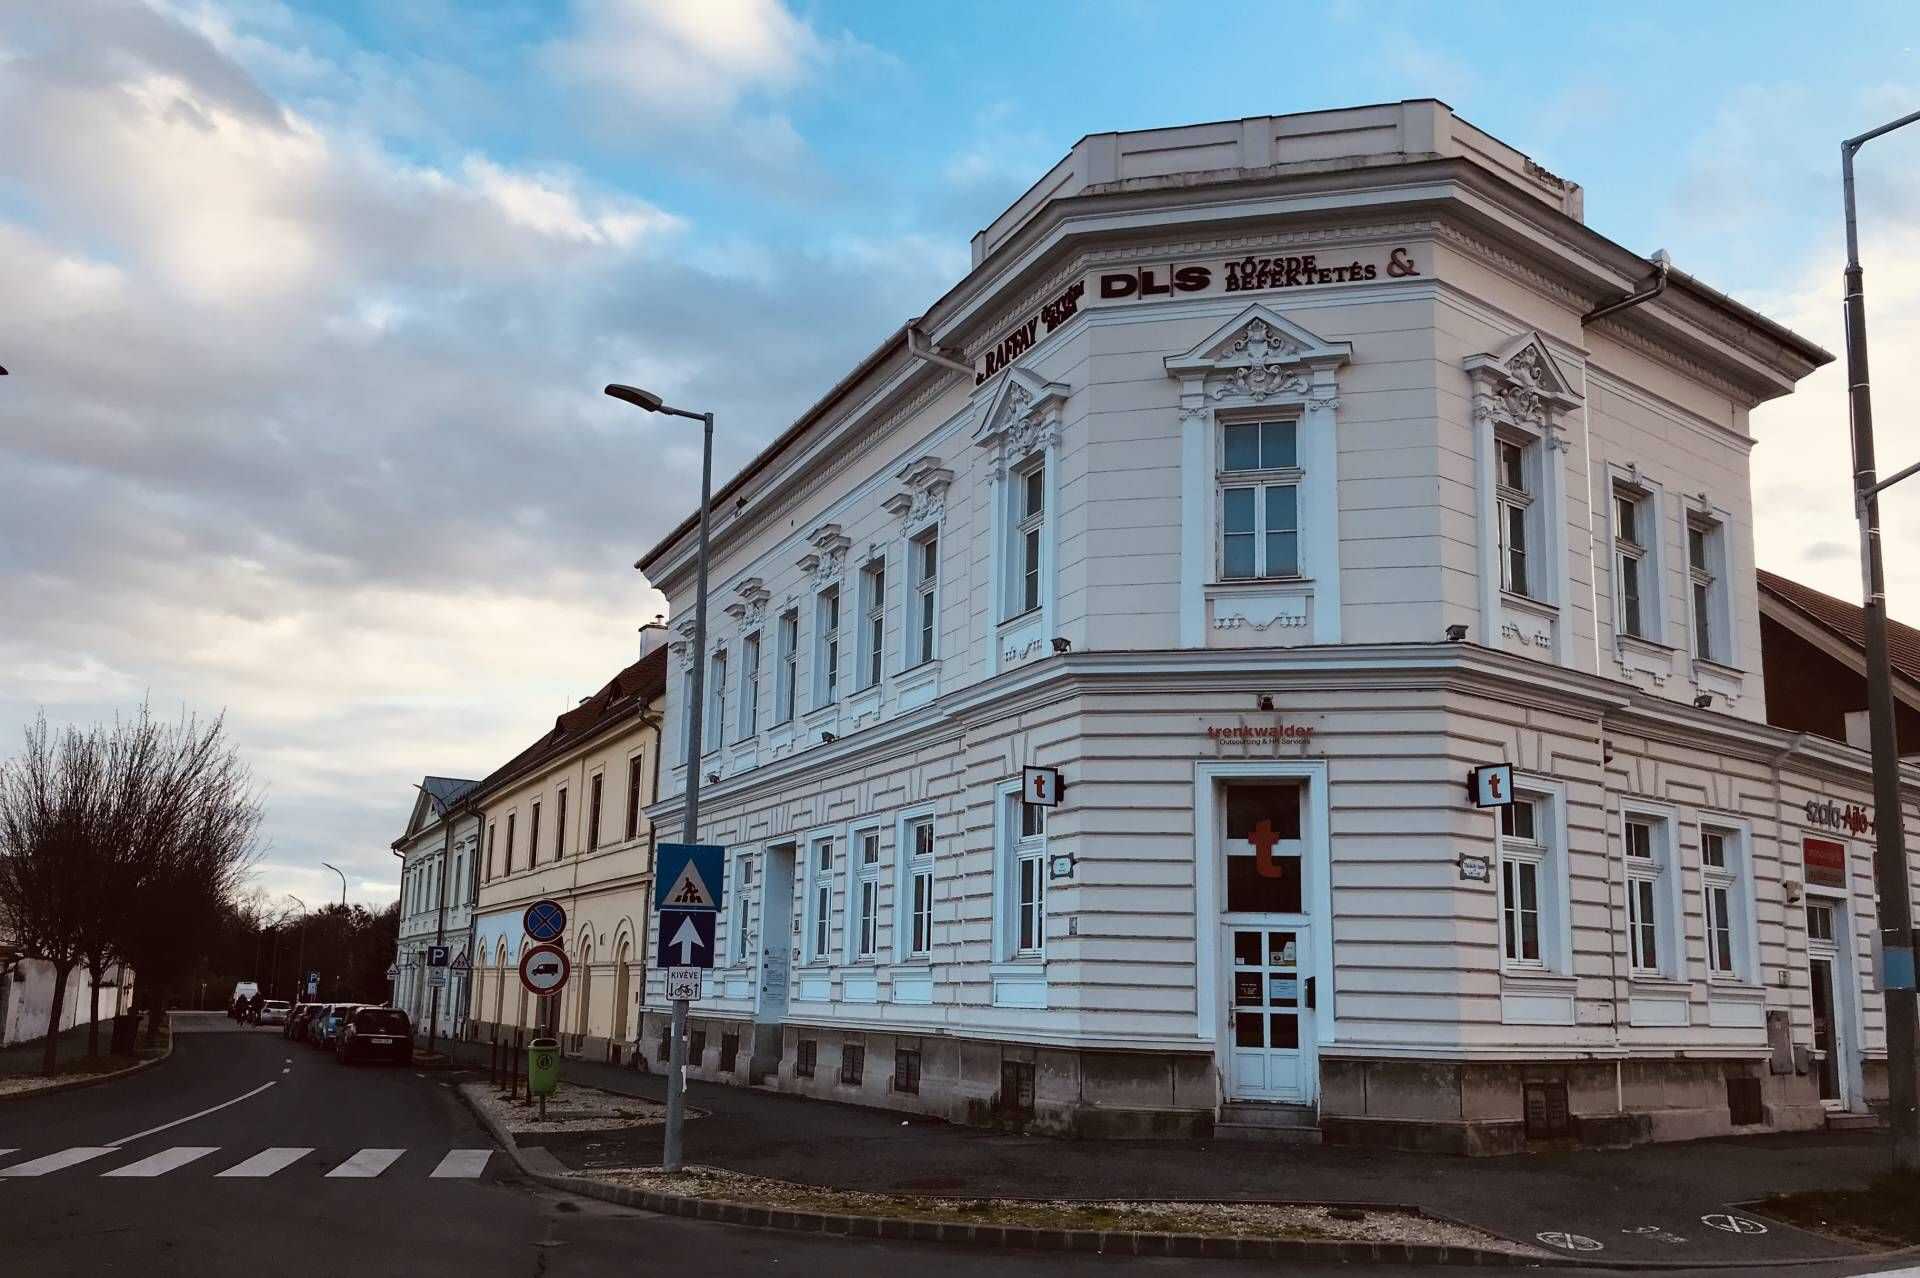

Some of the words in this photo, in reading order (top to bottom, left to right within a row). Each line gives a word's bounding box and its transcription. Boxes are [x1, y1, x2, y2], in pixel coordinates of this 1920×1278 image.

[1225, 261, 1377, 292] BEFEKTETÉS
[1387, 247, 1420, 278] &
[1101, 266, 1212, 299] DLS
[1207, 724, 1314, 738] trenkwalder
[1034, 774, 1046, 799] t
[1488, 773, 1502, 799] t
[1247, 819, 1282, 878] t
[432, 948, 445, 965] P
[671, 969, 699, 979] KIVÉVE
